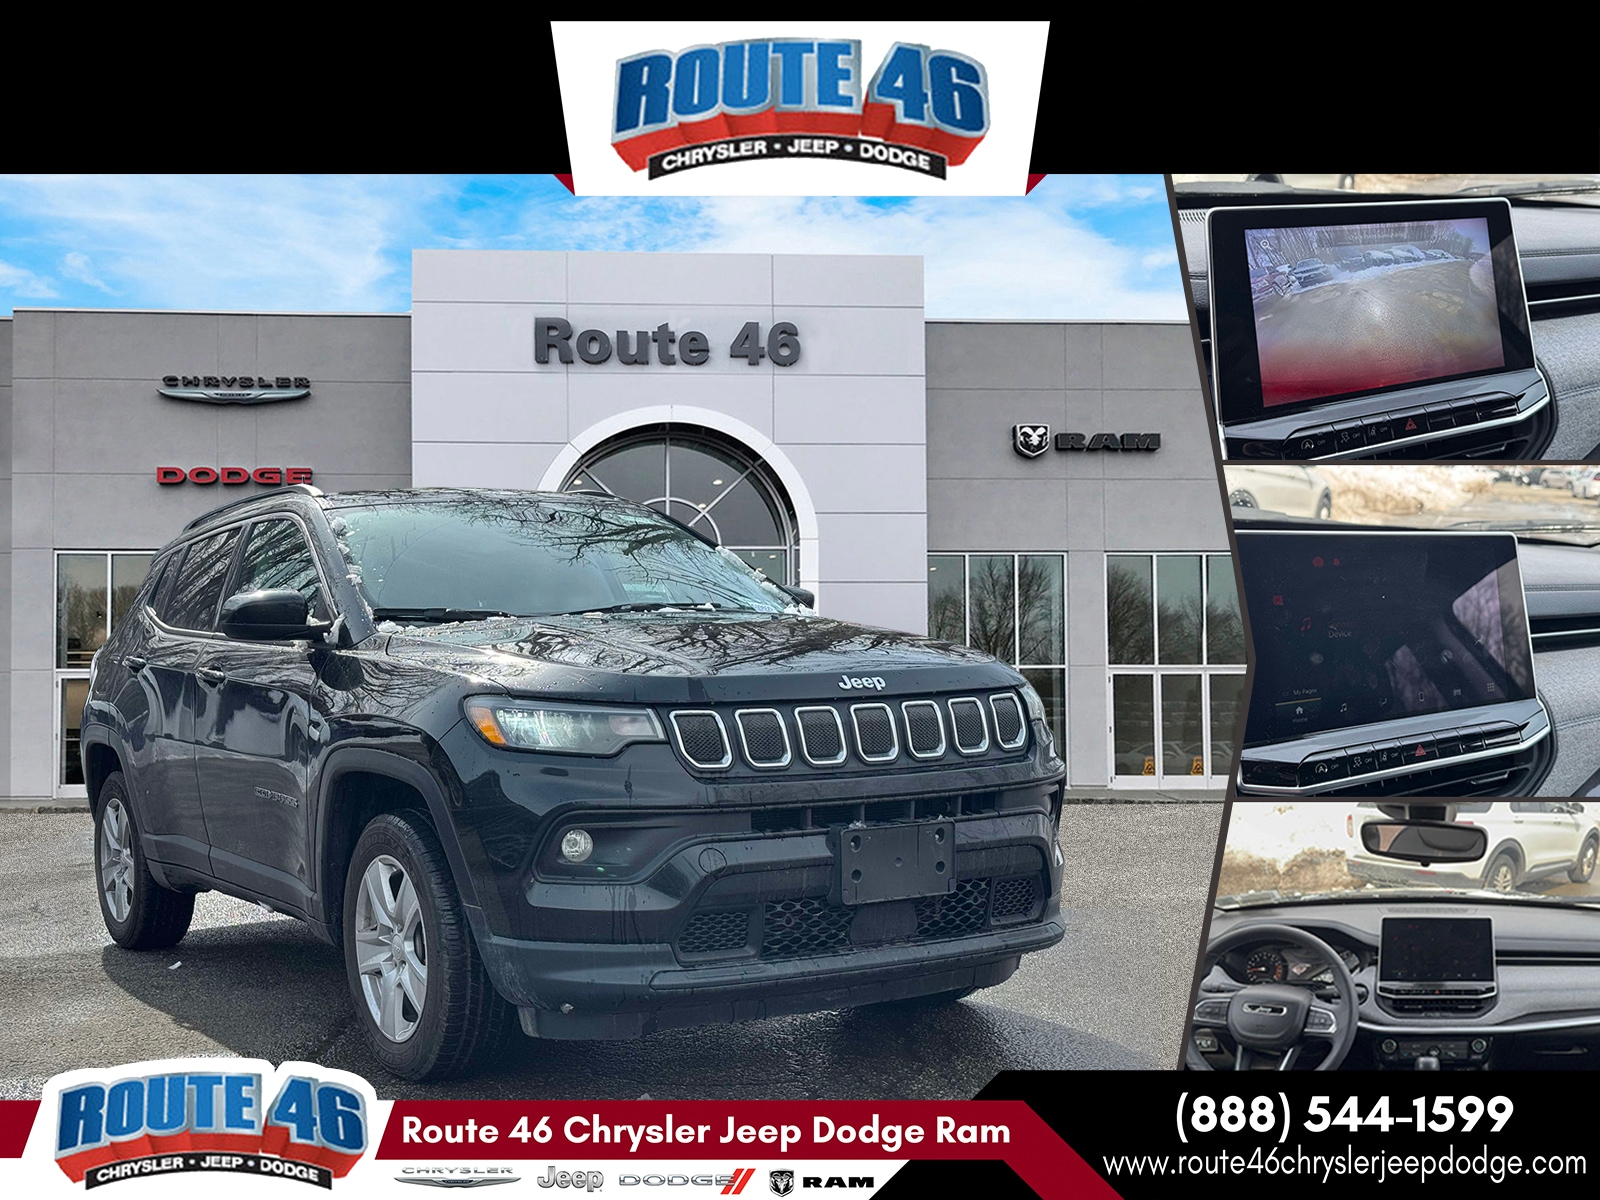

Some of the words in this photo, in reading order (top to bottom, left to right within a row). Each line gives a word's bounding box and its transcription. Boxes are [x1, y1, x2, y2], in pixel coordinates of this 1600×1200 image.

[534, 317, 710, 366] Route
[730, 321, 802, 367] 46
[161, 375, 311, 388] CHRYSLER
[1055, 432, 1161, 452] RAM
[156, 466, 313, 485] DODGE
[838, 674, 886, 691] Jeep
